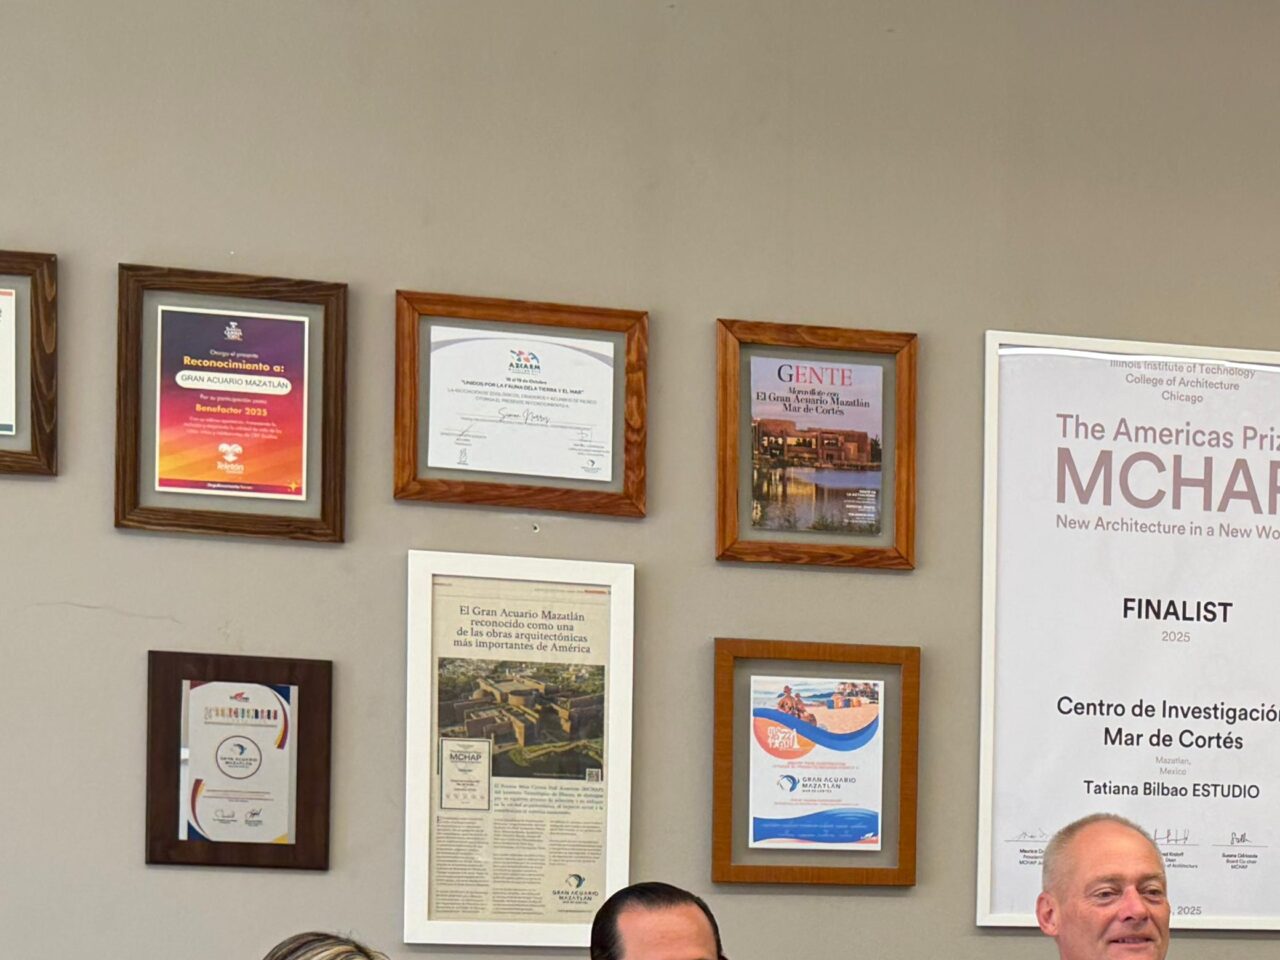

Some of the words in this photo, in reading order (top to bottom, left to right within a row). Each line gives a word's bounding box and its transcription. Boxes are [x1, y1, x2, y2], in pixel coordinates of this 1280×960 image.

[184, 356, 270, 371] Reconocimiento
[273, 364, 284, 372] a:
[1144, 361, 1184, 372] Institute
[1187, 362, 1196, 373] of
[1199, 364, 1256, 379] Technology
[181, 374, 204, 383] GRAN
[207, 376, 243, 386] ACUARIO
[246, 378, 288, 389] MAZATLÁN
[778, 364, 852, 386] GENTE
[1126, 374, 1163, 387] College
[1166, 376, 1176, 386] of
[1179, 377, 1240, 391] Architecture
[756, 392, 766, 401] El
[768, 393, 790, 402] Gran
[794, 395, 828, 405] Acuario
[830, 397, 870, 408] Mazatlán
[1162, 390, 1204, 405] Chicago
[196, 404, 242, 414] Benefactor
[245, 408, 268, 416] 2025
[782, 403, 802, 413] Mar
[804, 405, 814, 414] de
[816, 406, 845, 416] Cortés
[1056, 414, 1105, 440] The
[1113, 418, 1234, 449] Americas
[1056, 515, 1090, 530] New
[1094, 516, 1186, 535] Architecture
[1190, 522, 1202, 536] in
[1206, 527, 1215, 536] a
[1219, 524, 1252, 538] New
[460, 606, 469, 615] El
[472, 606, 497, 616] Gran
[500, 609, 538, 619] Acuario
[541, 610, 585, 621] Mazatlán
[1124, 598, 1233, 622] FINALIST
[471, 619, 524, 628] reconocido
[527, 622, 554, 630] como
[456, 627, 468, 636] de
[471, 628, 483, 637] las
[486, 630, 512, 638] obras
[515, 632, 588, 642] arquitectónicas
[1162, 631, 1191, 642] 2025
[454, 639, 472, 647] más
[475, 640, 534, 650] importantes
[537, 642, 548, 651] de
[550, 643, 591, 653] América
[1057, 696, 1125, 717] Centro
[1132, 699, 1156, 717] de
[1104, 727, 1143, 746] Mar
[1149, 729, 1173, 747] de
[1179, 729, 1243, 749] Cortés
[1084, 780, 1139, 796] Tatiana
[1143, 782, 1188, 797] Bilbao
[1193, 784, 1260, 799] ESTUDIO
[1177, 906, 1202, 915] 2025
